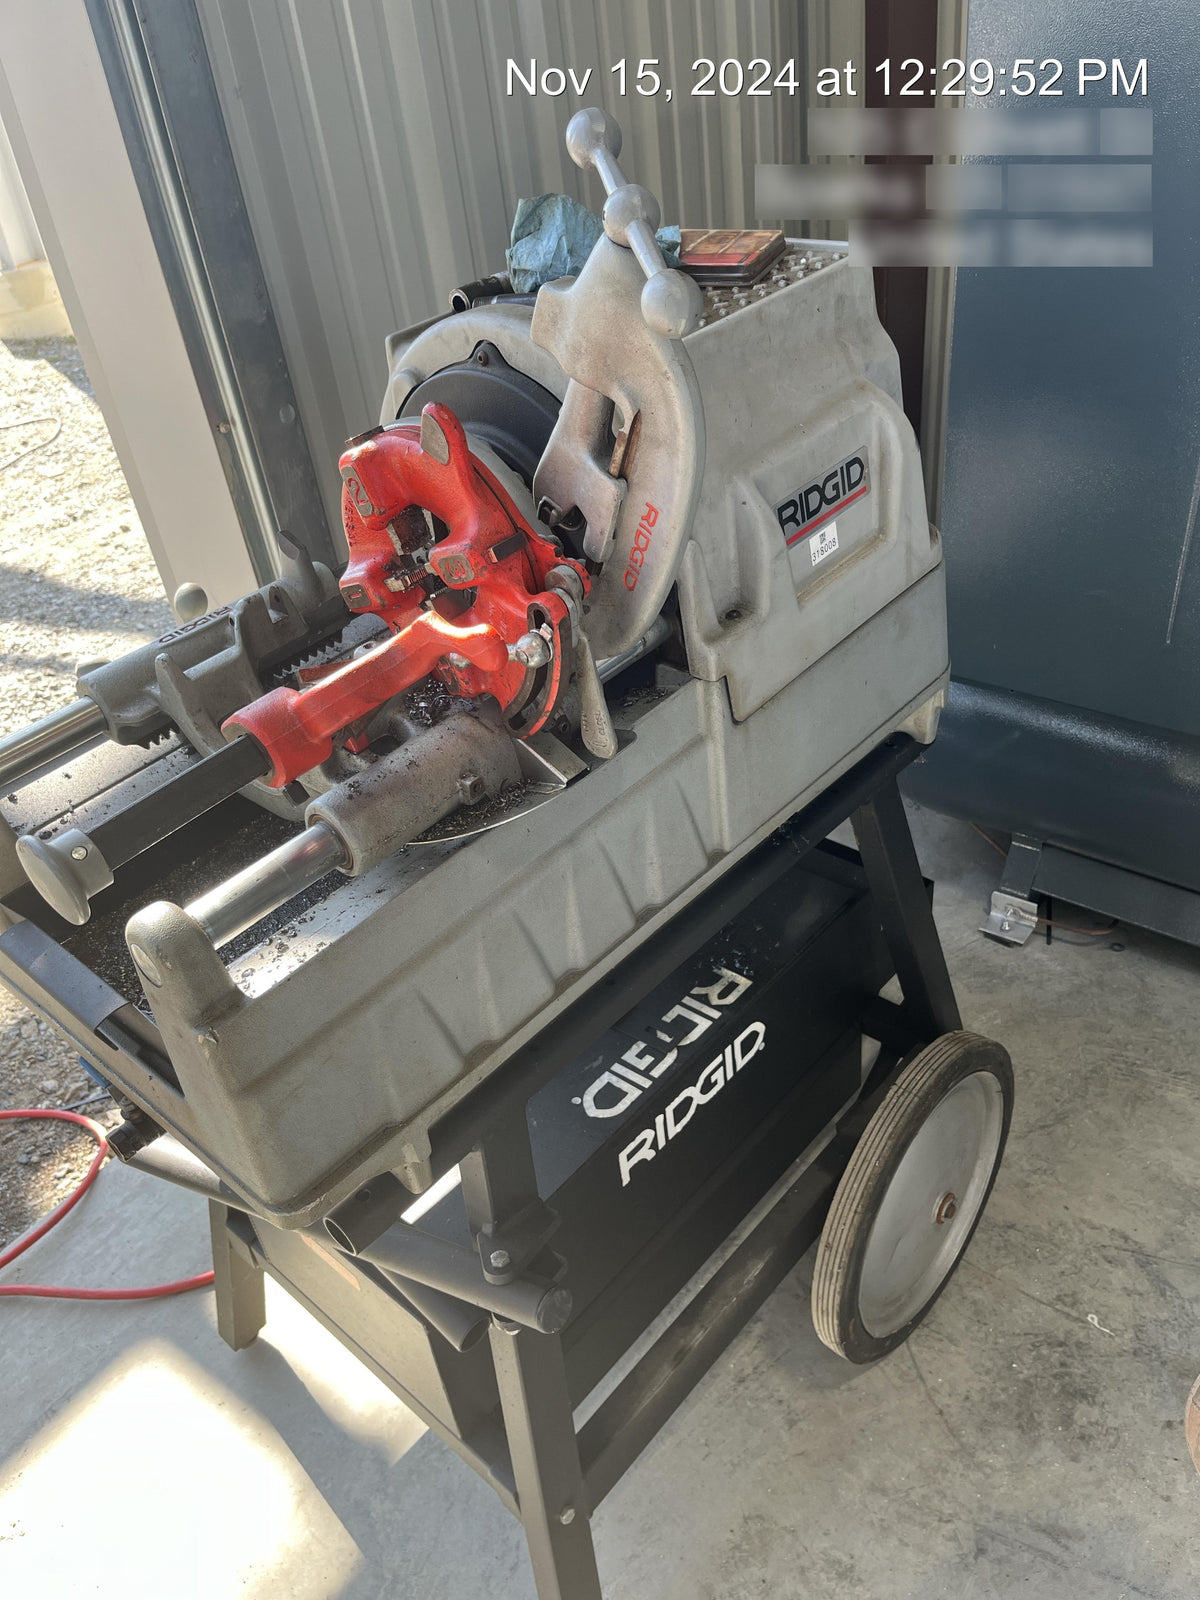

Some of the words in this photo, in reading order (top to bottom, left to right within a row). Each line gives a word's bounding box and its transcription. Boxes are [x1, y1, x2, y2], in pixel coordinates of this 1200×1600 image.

[777, 456, 865, 536] RIDGID
[623, 502, 660, 592] RIDGID
[159, 606, 233, 643] RIDGID
[618, 1021, 766, 1187] RIDGID
